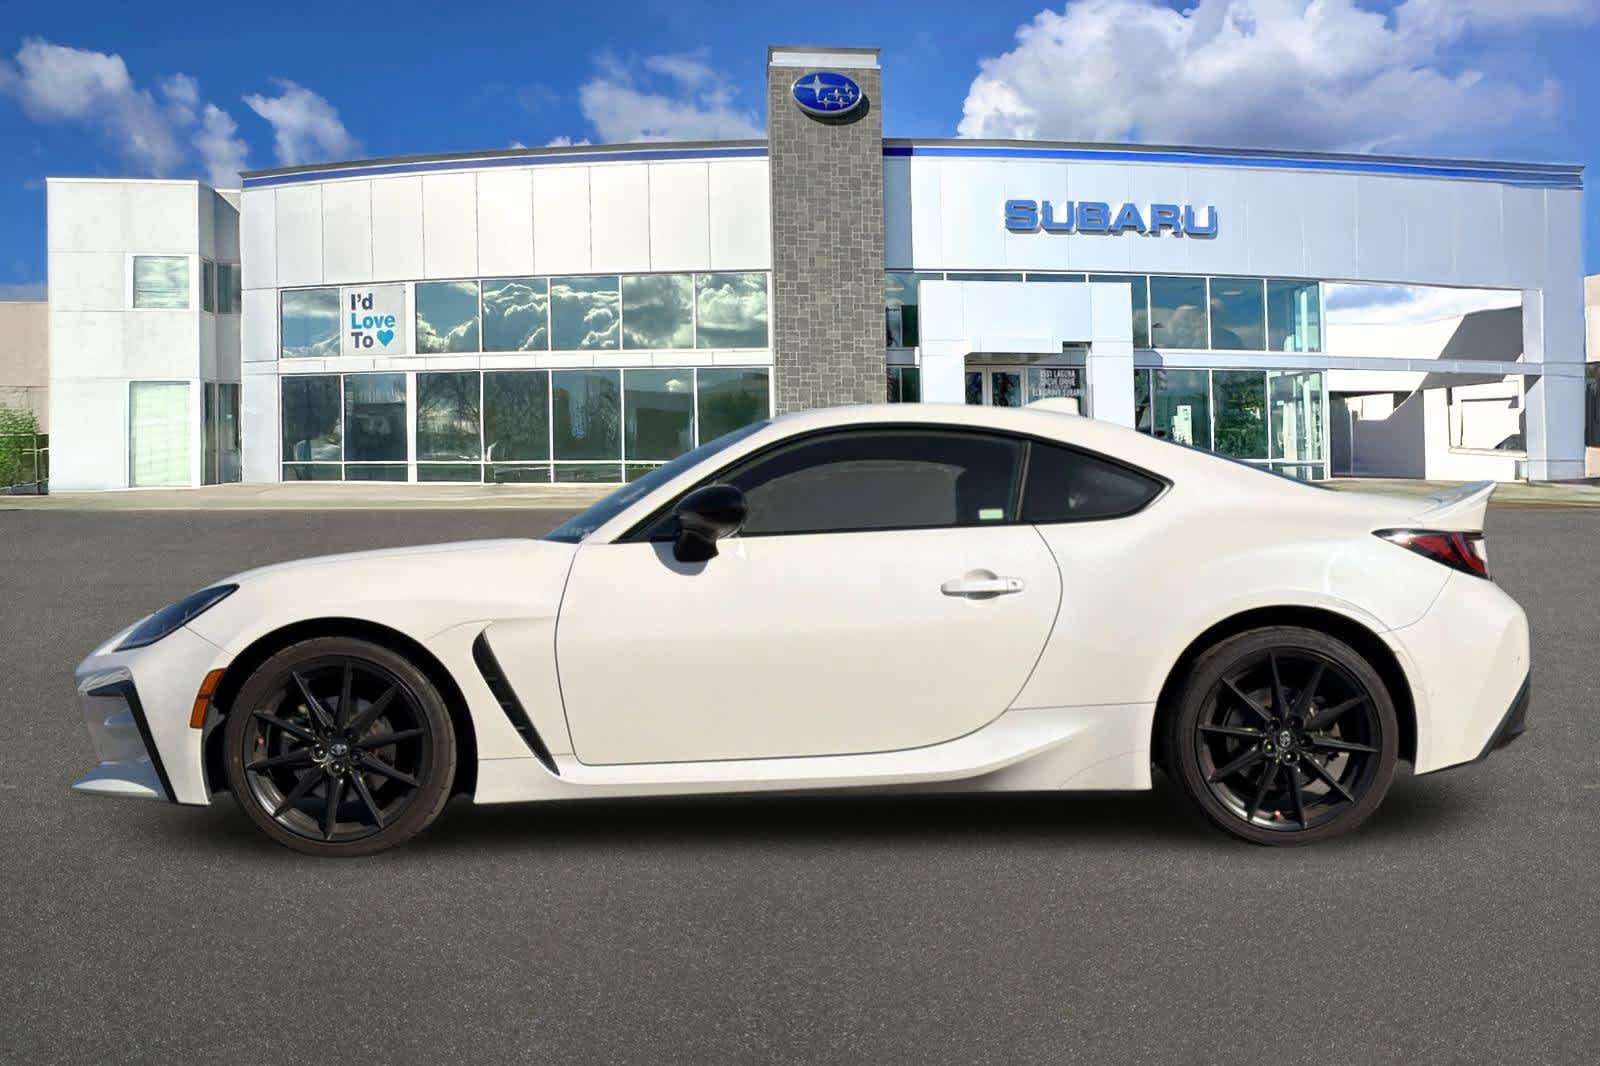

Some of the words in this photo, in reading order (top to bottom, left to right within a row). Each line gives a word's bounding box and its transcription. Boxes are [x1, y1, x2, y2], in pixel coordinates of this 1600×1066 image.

[1004, 199, 1217, 239] SUBARU
[351, 312, 396, 329] Love
[351, 331, 374, 348] To
